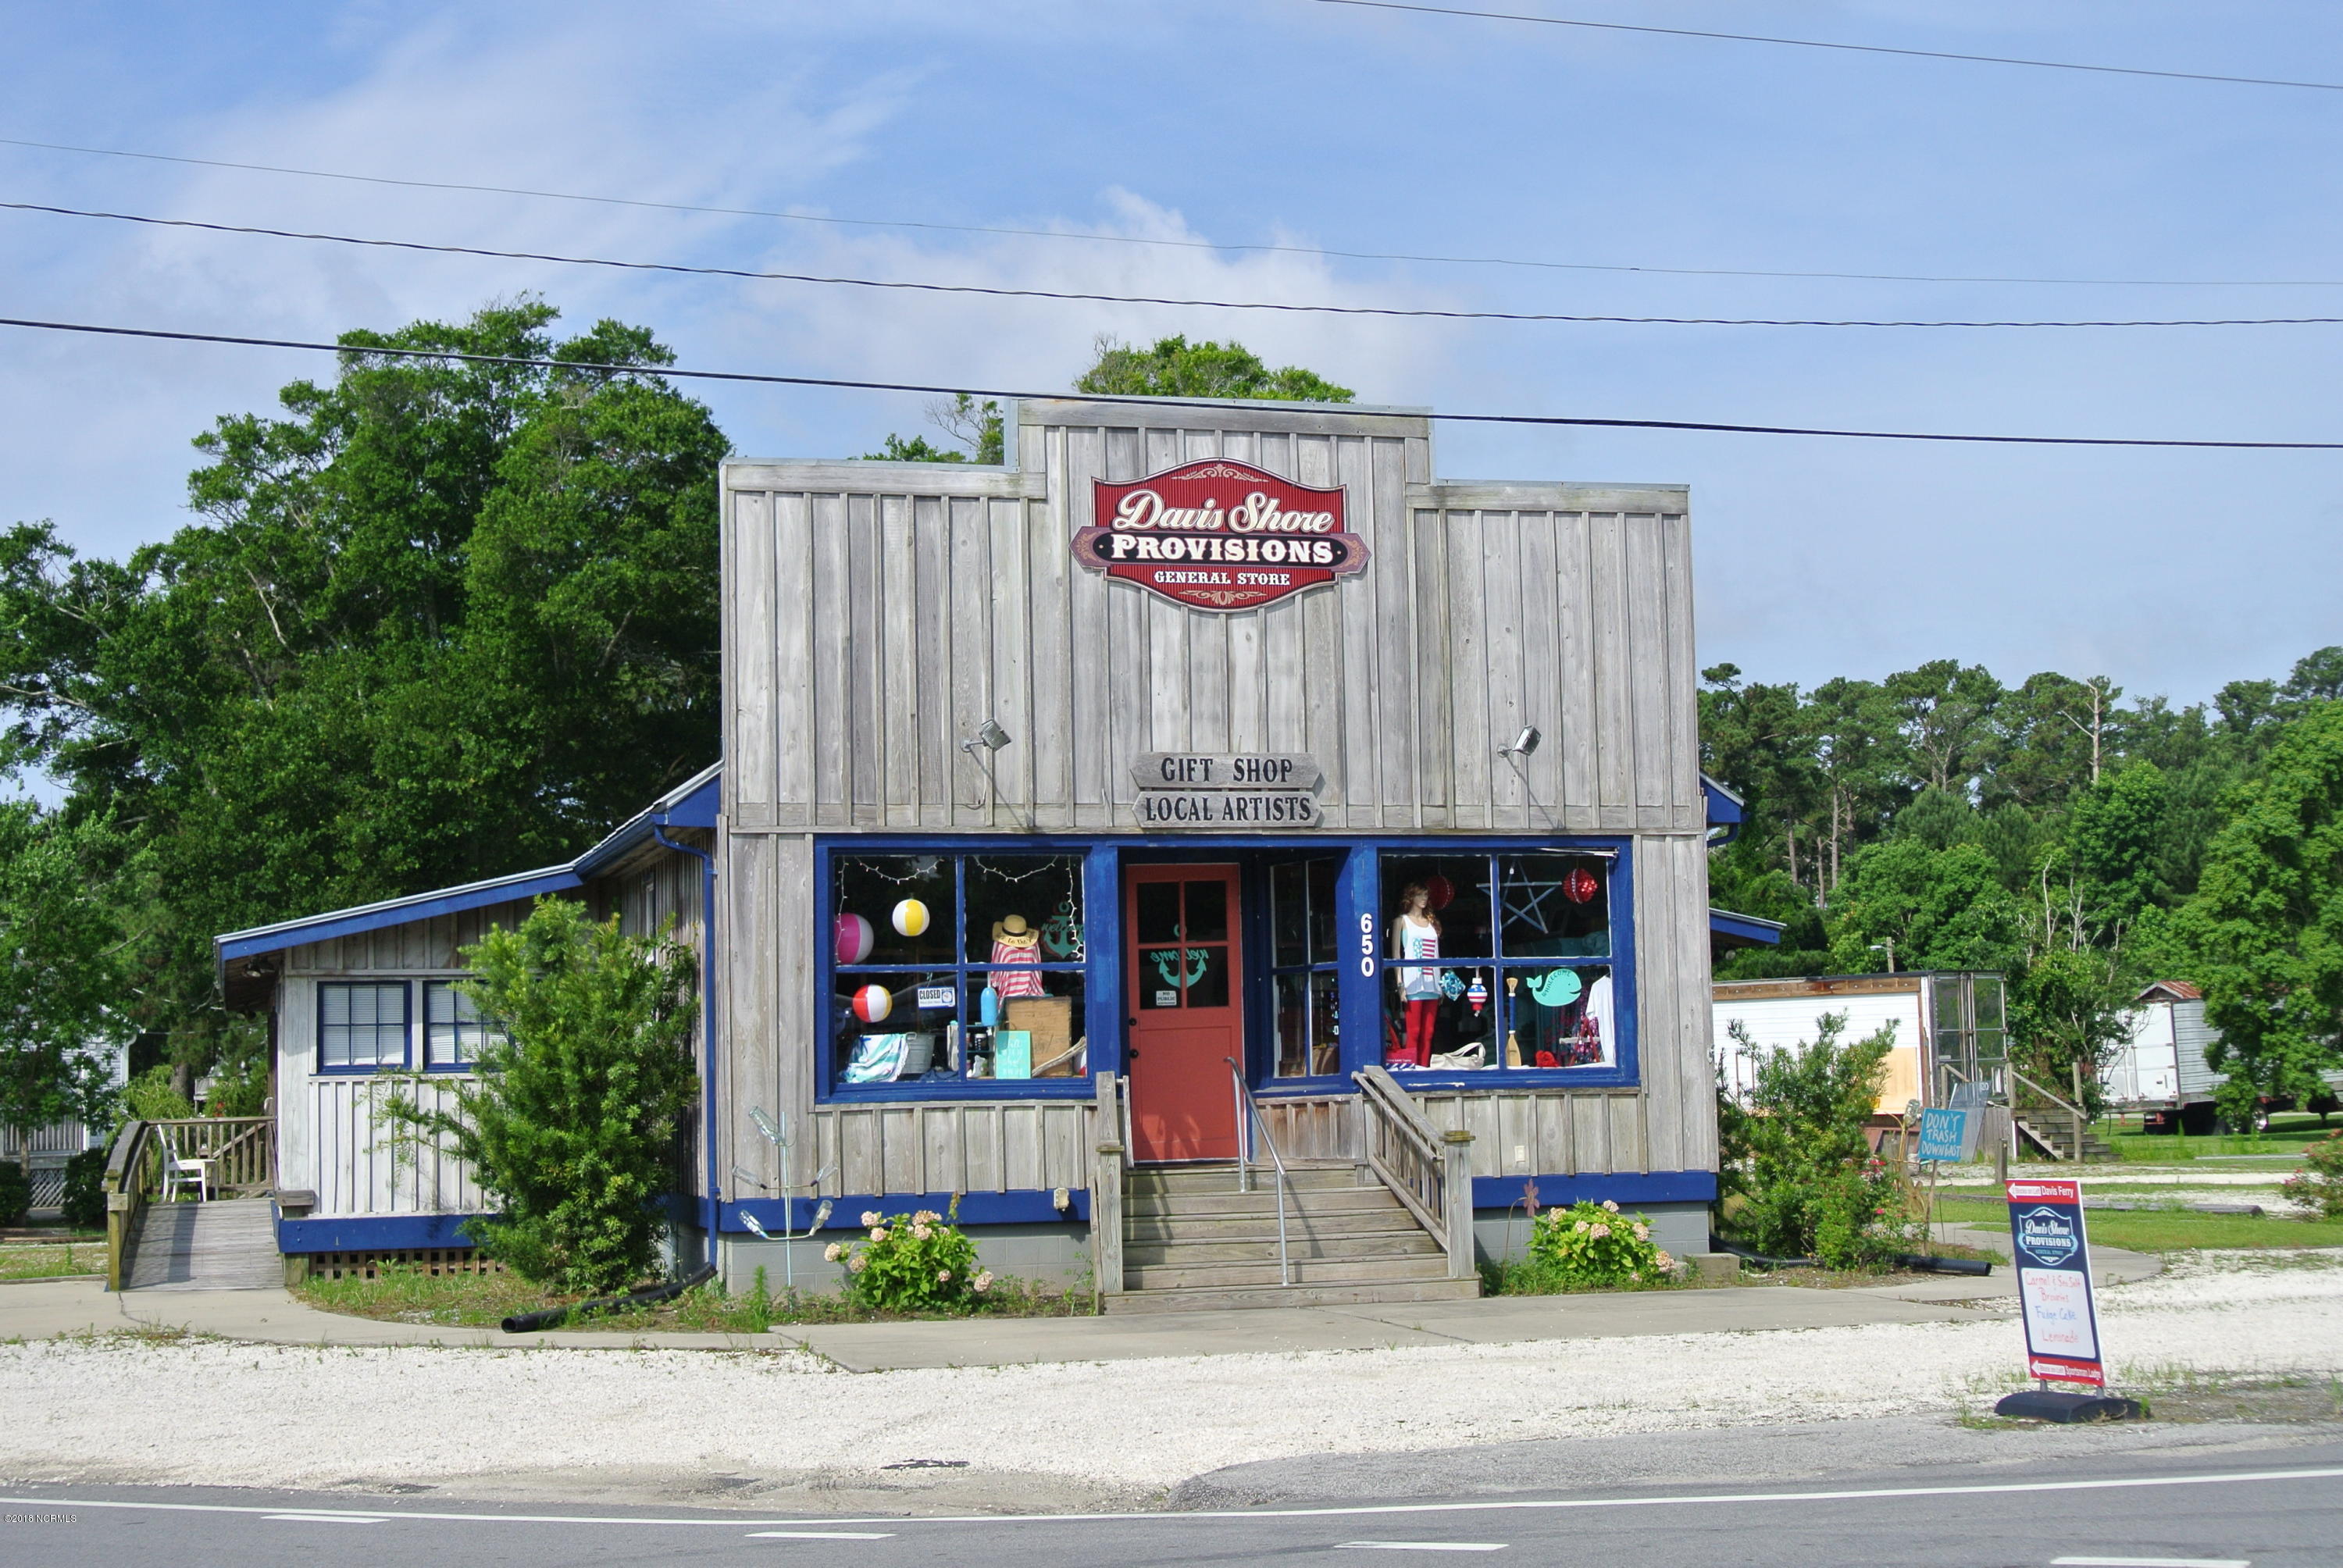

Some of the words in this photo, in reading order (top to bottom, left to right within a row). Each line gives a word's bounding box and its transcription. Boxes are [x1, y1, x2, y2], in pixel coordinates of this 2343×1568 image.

[1112, 489, 1224, 531] Davis
[1229, 492, 1334, 533] Shore
[1110, 533, 1333, 564] PROVISIONS
[1154, 571, 1231, 584] GENERAL
[1237, 572, 1290, 586] STORE
[1161, 757, 1213, 782] GIFT
[1232, 758, 1293, 782] SHOP
[1145, 796, 1213, 821] LOCAL
[1222, 796, 1311, 821] ARTISTS
[1360, 913, 1375, 978] 650
[919, 989, 941, 1000] CLOSED
[1926, 1113, 1961, 1131] DON'T
[1926, 1129, 1957, 1143] TRASH
[2042, 1185, 2058, 1196] Davis
[2058, 1186, 2074, 1199] Ferry
[2025, 1219, 2048, 1235] Davis
[2025, 1235, 2071, 1247] PROVISIONS
